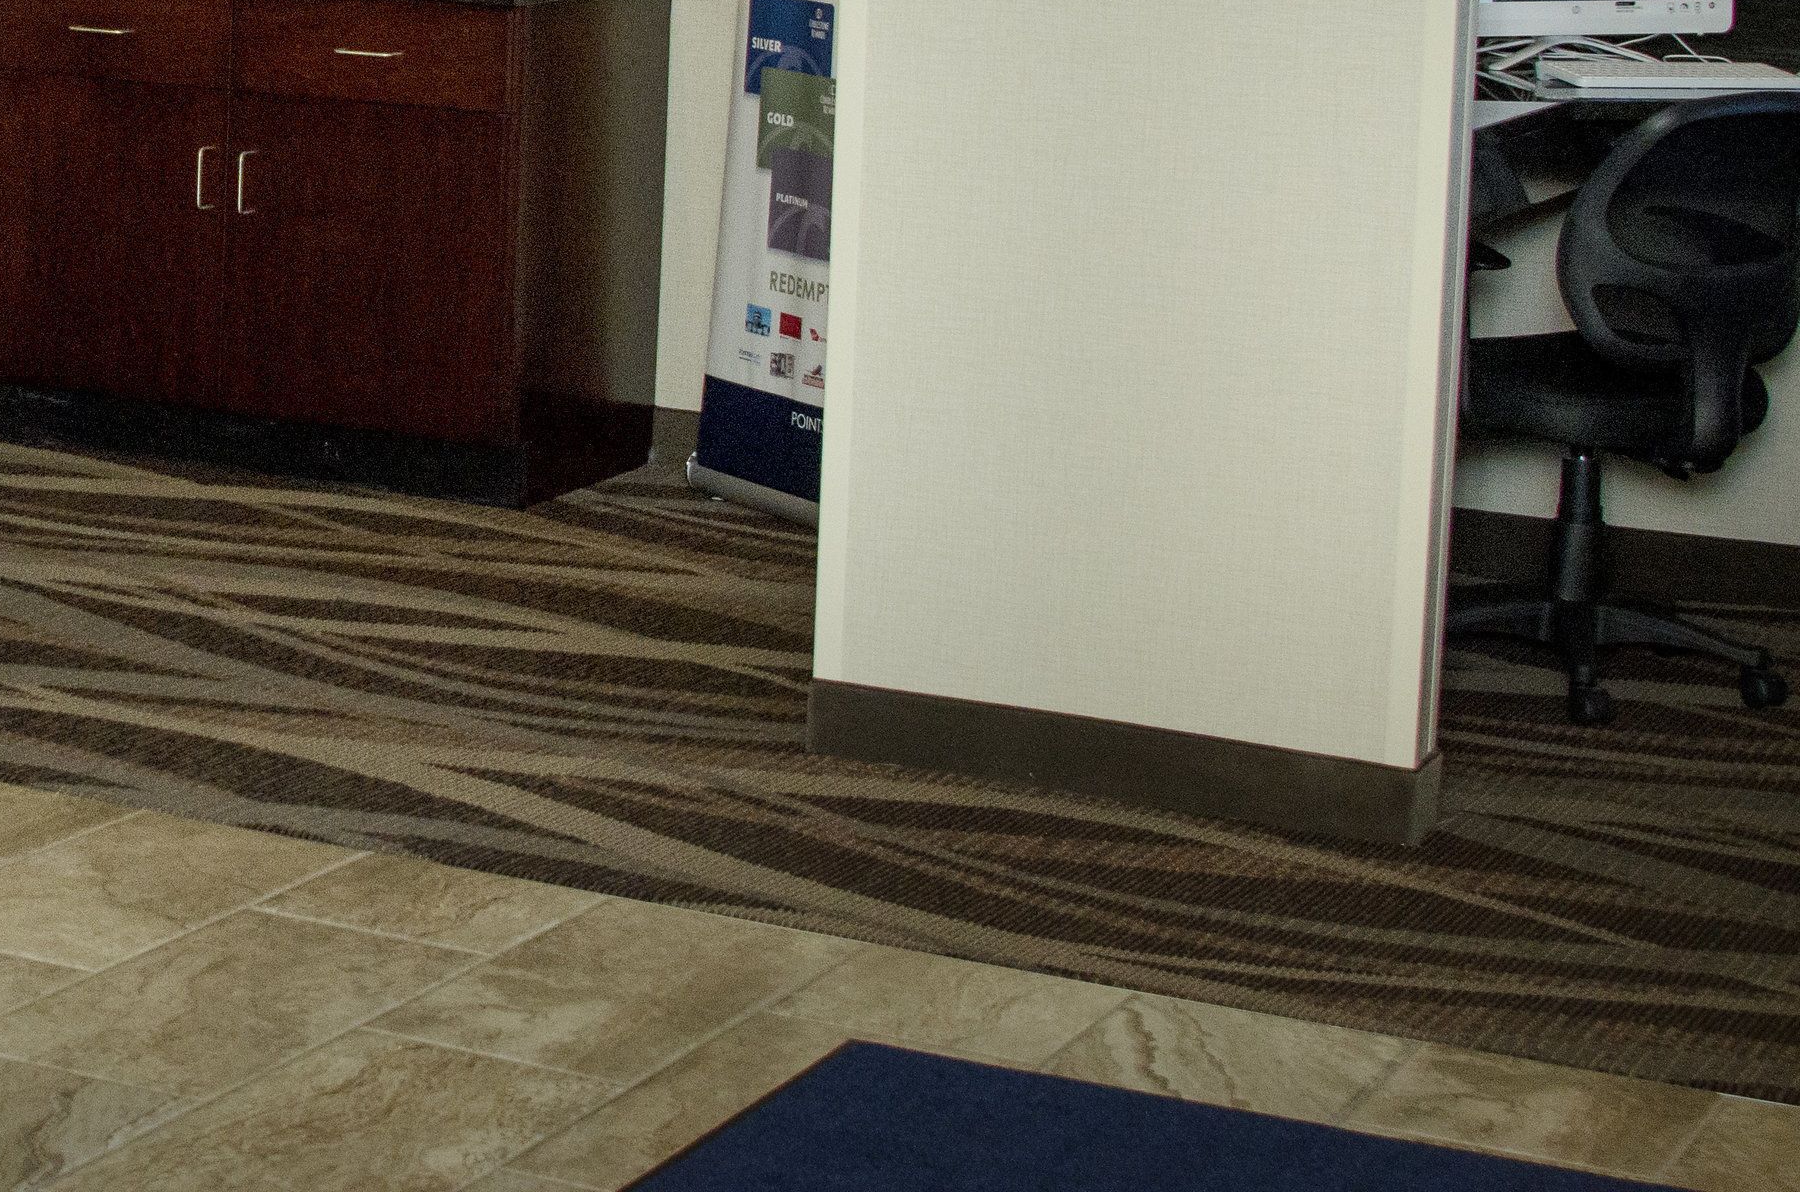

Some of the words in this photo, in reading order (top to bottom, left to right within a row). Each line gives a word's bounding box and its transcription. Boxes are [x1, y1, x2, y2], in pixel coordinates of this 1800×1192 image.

[751, 37, 782, 53] SILVER
[767, 111, 794, 127] GOLD
[776, 192, 808, 207] PLATINUM
